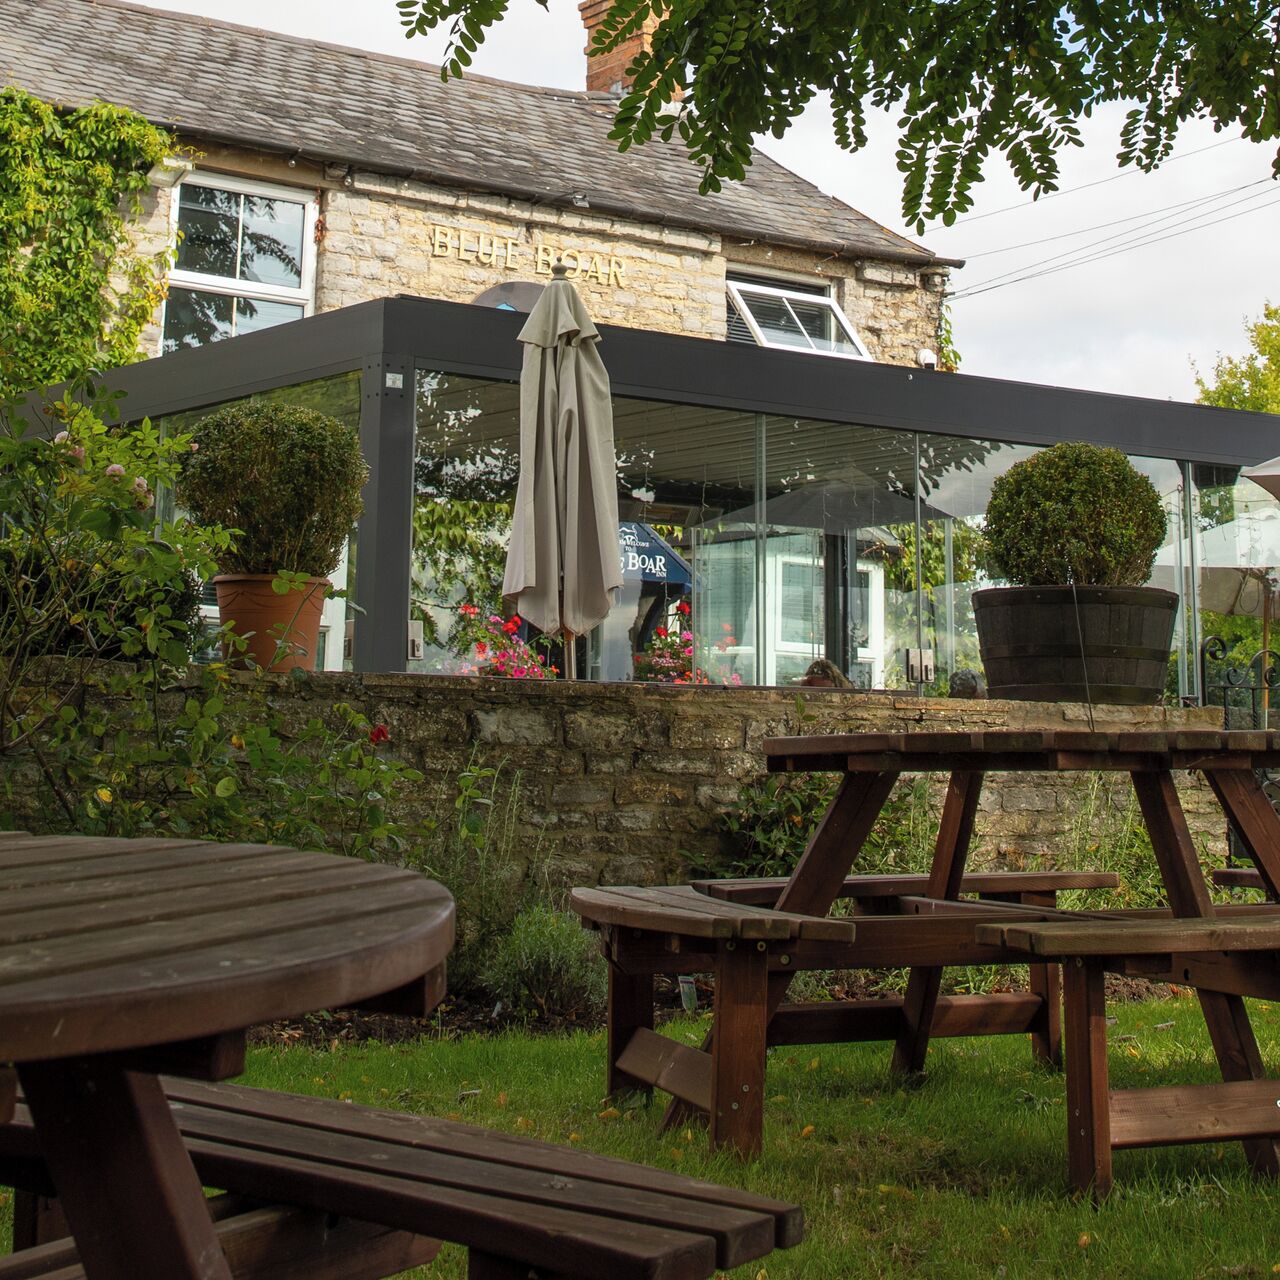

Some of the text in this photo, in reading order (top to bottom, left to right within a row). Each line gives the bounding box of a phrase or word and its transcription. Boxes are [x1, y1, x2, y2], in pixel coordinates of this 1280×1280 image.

[432, 225, 626, 288] BLUE BOAR
[627, 552, 667, 573] BOAR
